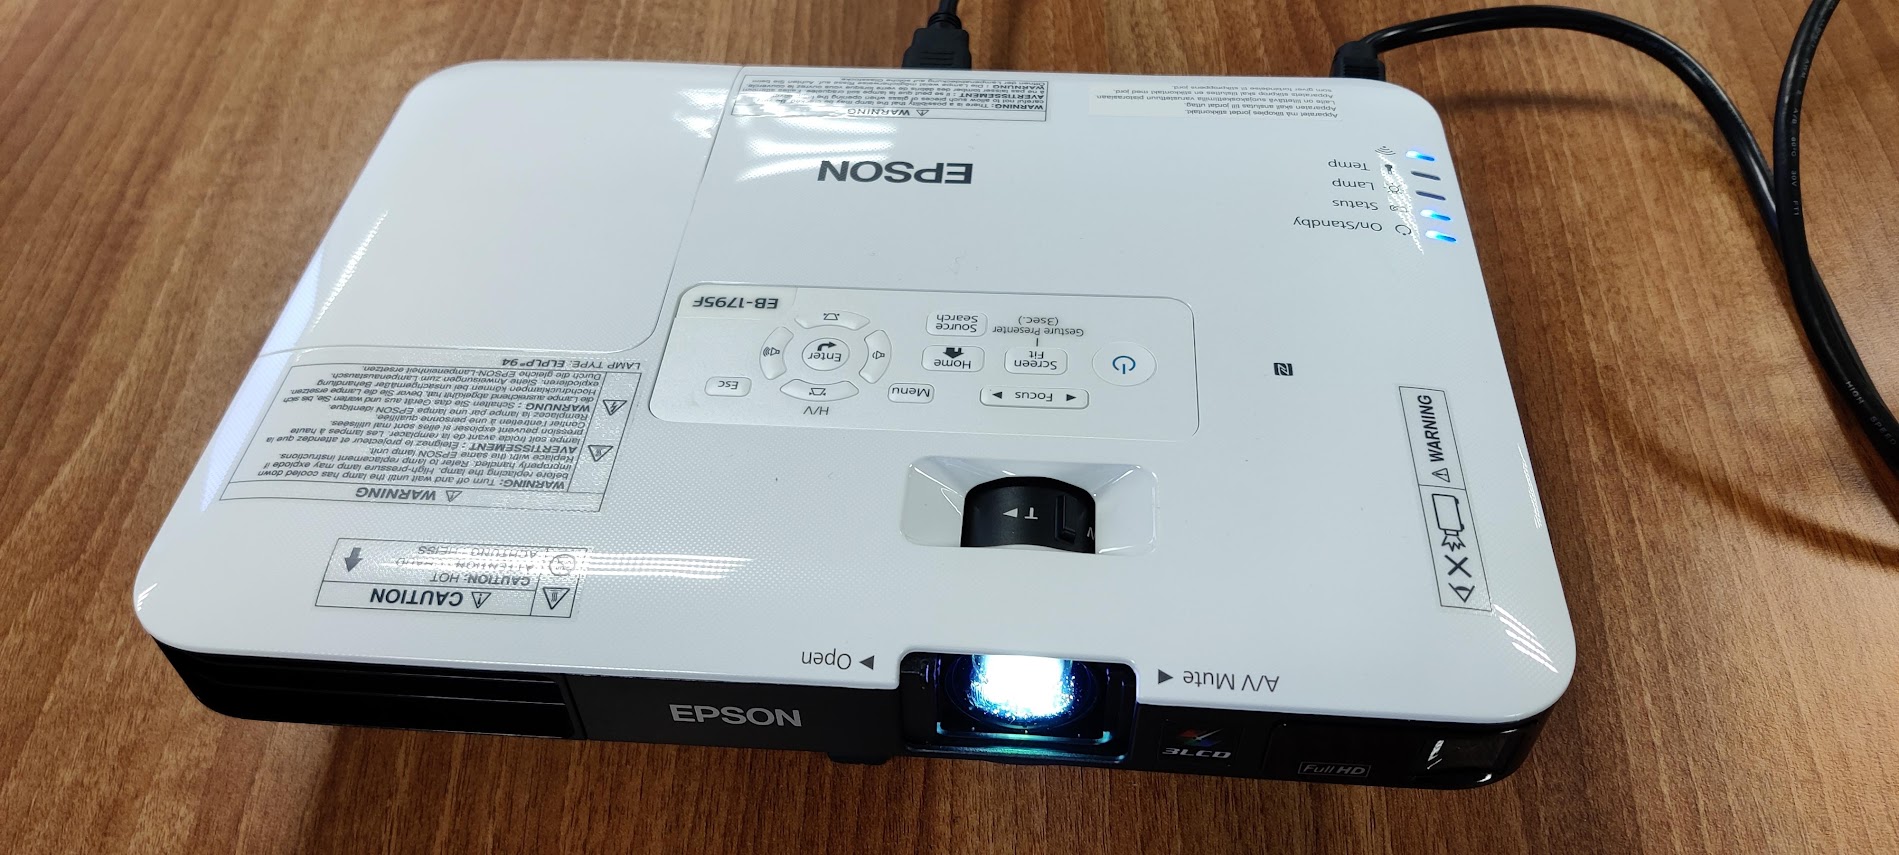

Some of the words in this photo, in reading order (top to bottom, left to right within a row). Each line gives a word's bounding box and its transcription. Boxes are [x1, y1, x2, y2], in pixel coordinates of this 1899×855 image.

[1328, 158, 1370, 171] Temp
[817, 160, 973, 184] EPSON
[1332, 178, 1375, 190] Lamp
[1332, 200, 1378, 210] Status
[1292, 216, 1382, 232] On/Standby
[692, 296, 780, 309] EB-1795F
[936, 314, 978, 323] Search
[1018, 315, 1059, 326] (3sec.)
[935, 323, 978, 333] Source
[992, 326, 1041, 336] Presenter
[1044, 326, 1084, 337] Gesture
[808, 352, 842, 362] Enter
[1028, 350, 1044, 359] Fit
[570, 360, 603, 369] TYPE:
[607, 362, 640, 370] LAMP
[933, 359, 972, 369] Home
[1014, 359, 1058, 370] Screen
[327, 371, 419, 381] Lampenaustausch.
[442, 374, 508, 384] Anweisungen
[315, 378, 374, 387] Behandlung
[539, 378, 600, 387] explodieren.
[718, 380, 739, 390] Esc
[891, 387, 930, 397] Menu
[1014, 391, 1053, 402] Focus
[1846, 380, 1864, 404] HIGH
[325, 402, 375, 412] identique.
[415, 406, 447, 415] lampe
[524, 402, 591, 410] WARNUNG
[803, 405, 830, 416] H/V
[487, 408, 520, 417] lampe
[531, 410, 589, 419] Remplacez
[418, 414, 466, 422] personne
[326, 426, 365, 436] lampes
[452, 423, 496, 433] exploser
[496, 425, 539, 434] peuvent
[539, 426, 584, 436] pression
[1417, 395, 1444, 462] WARNING
[385, 429, 439, 439] remplacer.
[351, 436, 403, 446] projecteur
[548, 435, 580, 445] lampe
[389, 447, 416, 456] lamp
[468, 442, 577, 453] AVERTISSEMENT
[276, 453, 336, 461] instructions.
[336, 453, 400, 464] replacement
[416, 450, 458, 458] EPSON
[531, 453, 575, 462] Replace
[270, 460, 312, 469] explode
[400, 456, 427, 465] lamp
[440, 459, 469, 467] Refer
[471, 460, 516, 469] handled.
[335, 461, 363, 471] lamp
[362, 463, 435, 474] High-pressure
[436, 466, 466, 475] lamp.
[517, 461, 572, 471] improperly
[340, 470, 368, 480] lamp
[485, 468, 534, 478] replacing
[534, 471, 569, 479] before
[471, 477, 496, 485] Turn
[498, 478, 566, 488] WARNING:
[354, 486, 437, 500] WARNING
[1024, 507, 1038, 520] T
[429, 573, 460, 583] HOT
[462, 575, 530, 586] CAUTION:
[370, 588, 464, 606] CAUTION
[801, 648, 852, 670] Open
[1183, 671, 1235, 690] Mute
[1241, 675, 1280, 692] A/V
[669, 704, 802, 727] EPSON
[1162, 747, 1232, 759] 3LCD
[1303, 764, 1333, 774] Full
[1337, 765, 1366, 775] HD
